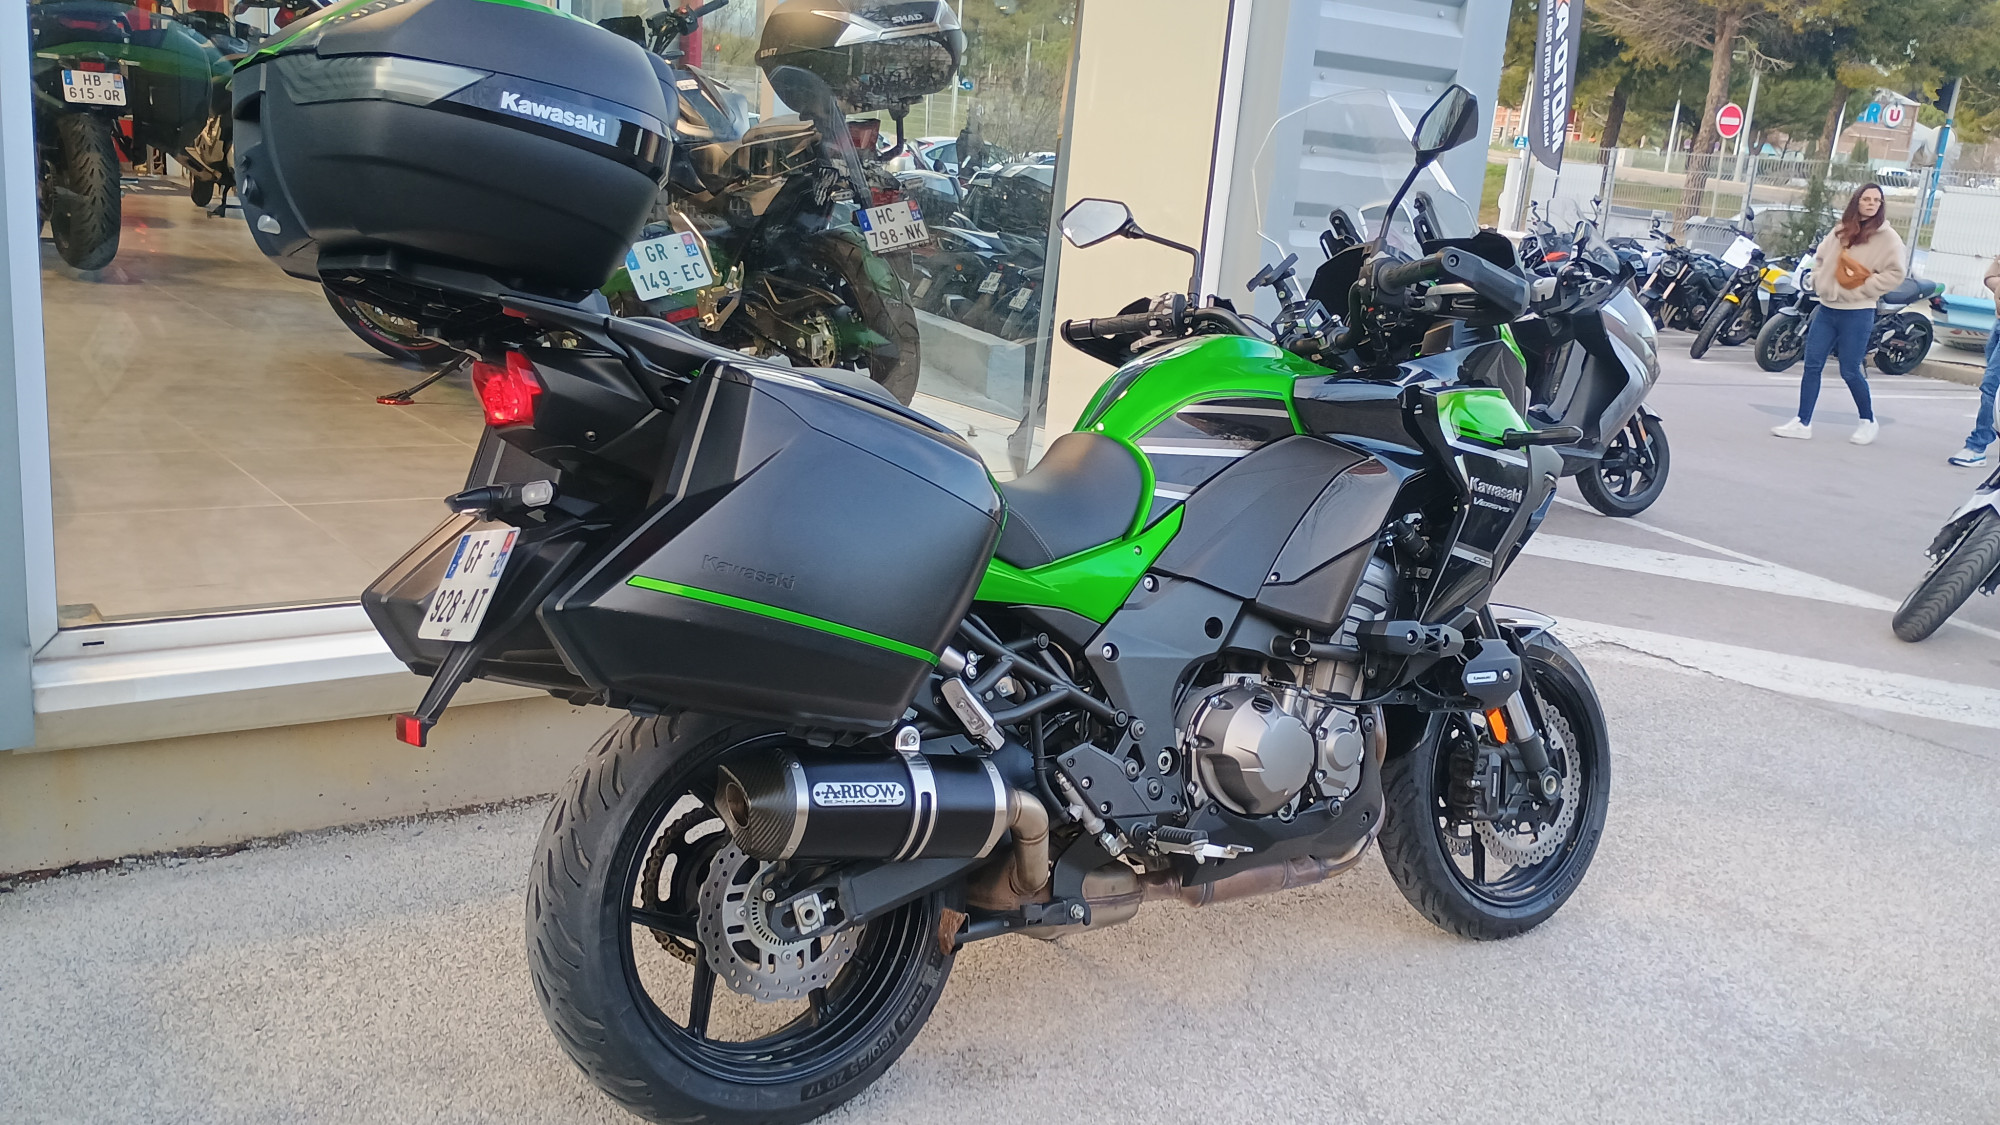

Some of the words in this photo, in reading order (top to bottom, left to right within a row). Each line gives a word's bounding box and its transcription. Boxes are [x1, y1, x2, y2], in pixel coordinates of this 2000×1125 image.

[892, 13, 923, 24] SHAD
[501, 90, 606, 137] Kawasaki
[869, 222, 925, 248] 798-NK
[686, 246, 698, 256] 34
[640, 262, 705, 292] 149-EC
[1469, 476, 1523, 504] Kawasaki
[701, 554, 796, 591] Kawasaki
[429, 588, 490, 624] 928-AT
[821, 784, 898, 799] ARROW
